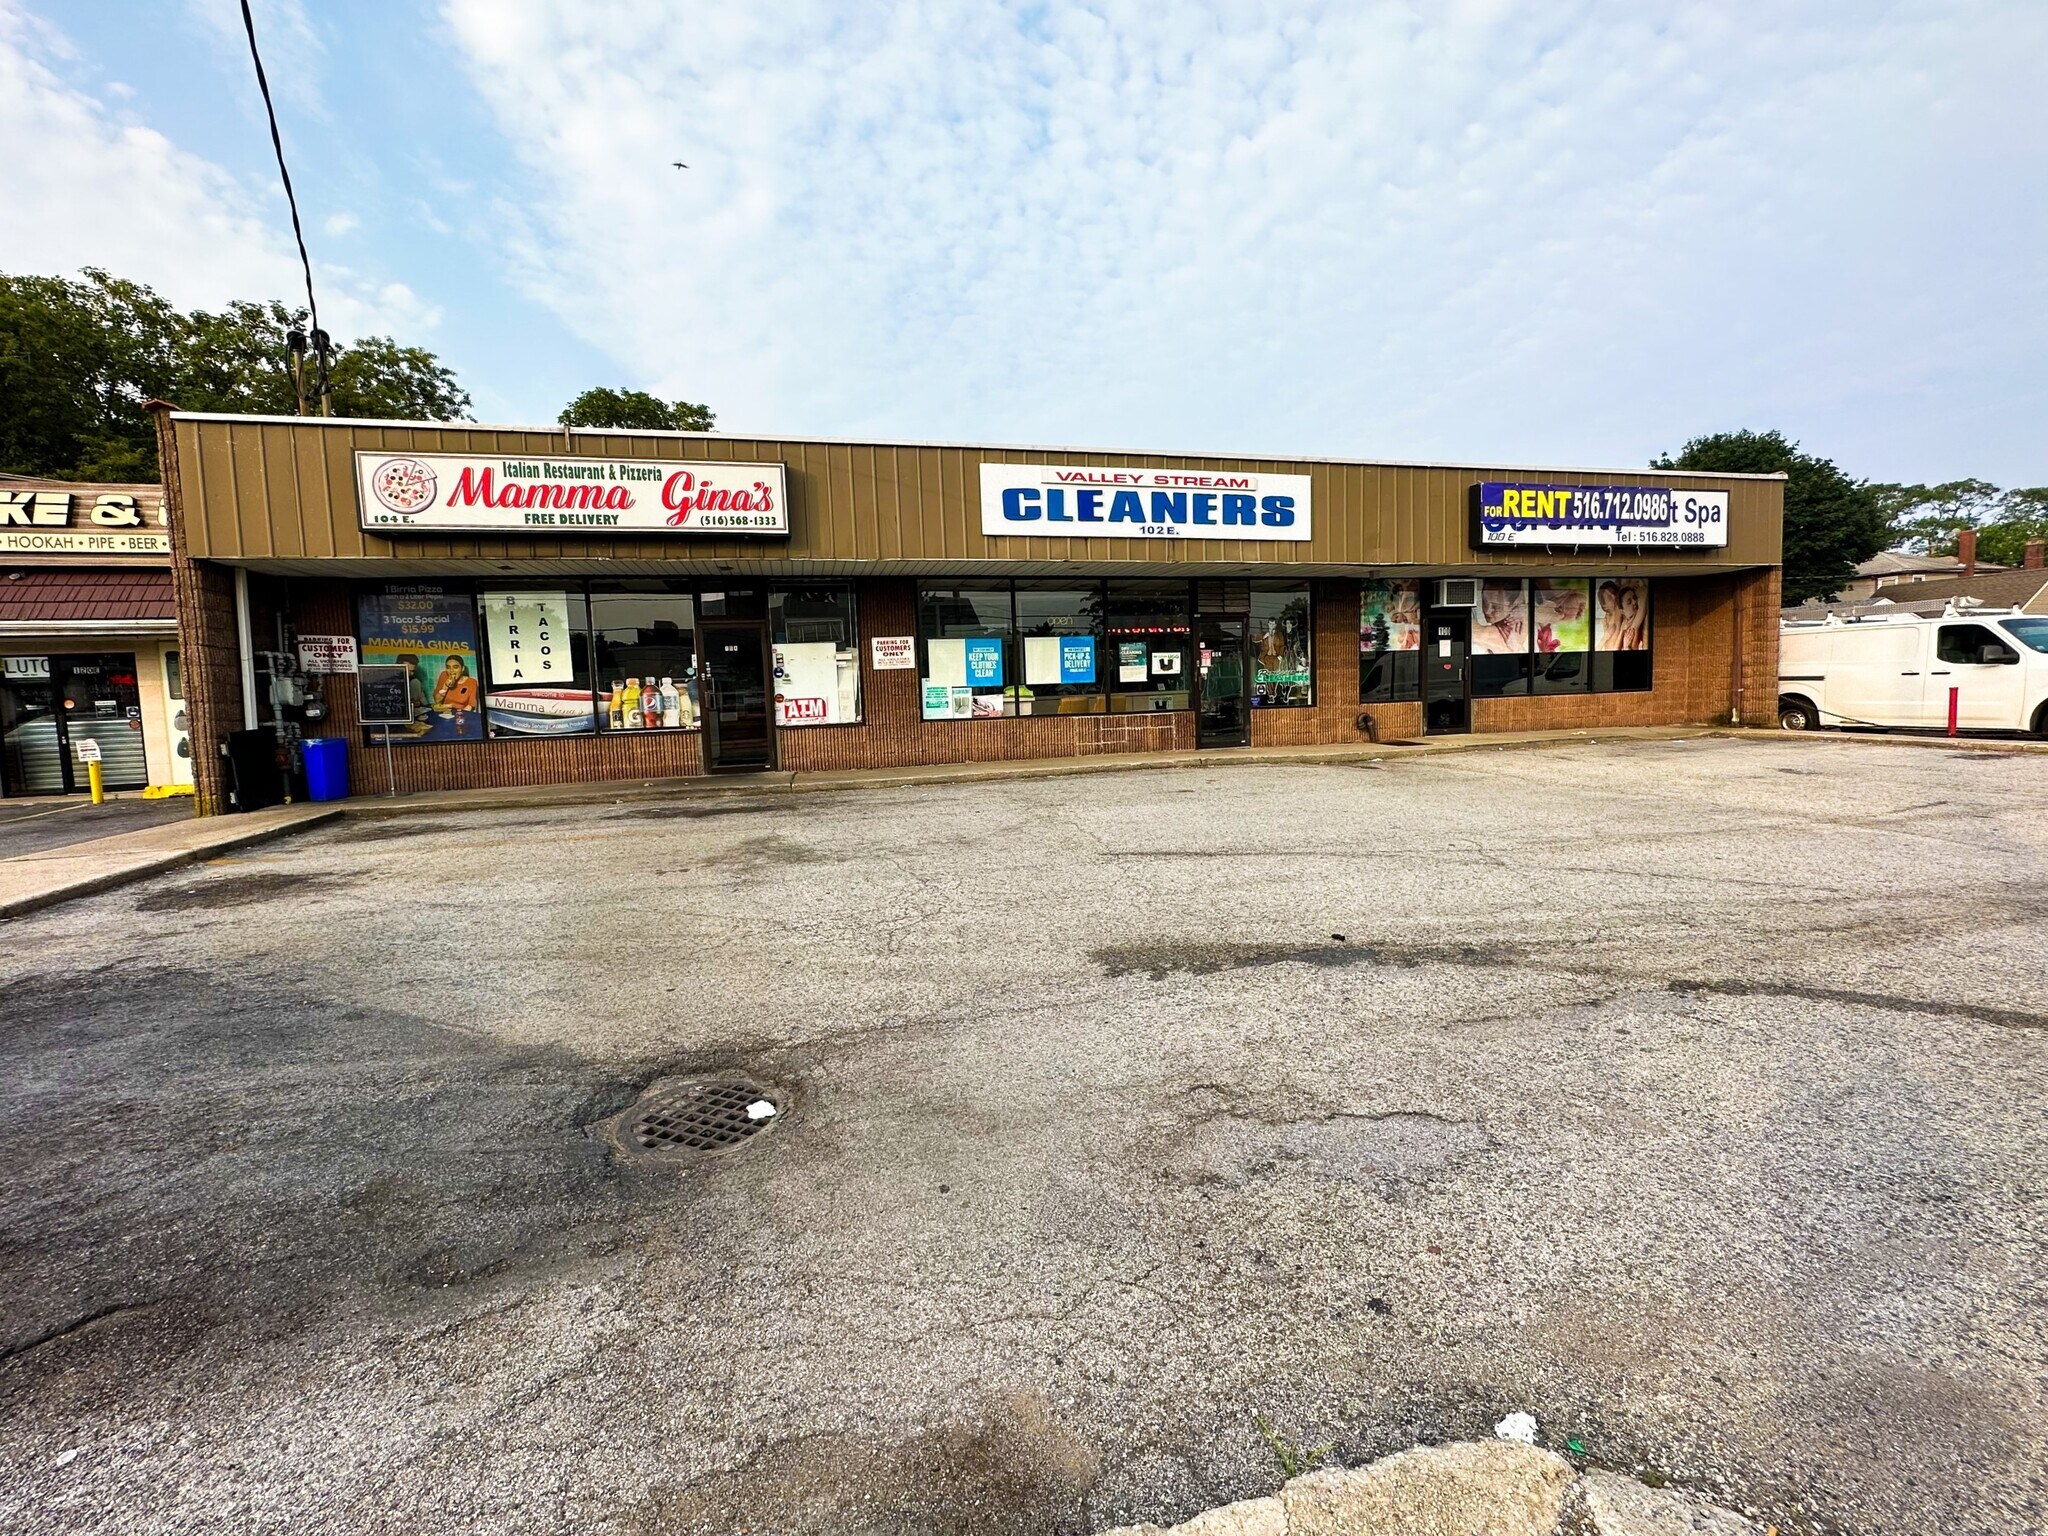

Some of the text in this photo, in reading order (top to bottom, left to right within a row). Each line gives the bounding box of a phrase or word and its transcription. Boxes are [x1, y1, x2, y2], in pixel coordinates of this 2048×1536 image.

[502, 462, 662, 482] Italian Restaurant & Pizzeria
[1056, 472, 1249, 488] VALLEY STREAM
[446, 467, 774, 526] Mamma Gina's
[90, 494, 140, 526] &
[1002, 488, 1295, 526] CLEANERS
[1484, 490, 1668, 521] FOR RENT 516.712.0986
[374, 514, 399, 523] 104
[1684, 498, 1721, 528] Spa
[524, 514, 620, 526] FREE DELIVERY
[700, 515, 776, 527] (516)568-1333
[8, 536, 158, 549] HOOKAH PIPE BEER
[1488, 533, 1516, 541] 100 E
[1639, 532, 1704, 543] 516.828.0888
[398, 601, 434, 610] $32.00
[384, 615, 450, 625] 3 Taco Special
[402, 625, 435, 634] $15.99
[537, 602, 551, 669] TACOS
[506, 596, 523, 678] BIRRIA
[368, 638, 470, 650] MAMMA GINAS
[969, 652, 999, 661] KEEP YOUR
[971, 661, 997, 669] CLOTHES
[1064, 660, 1091, 668] DELIVERY
[975, 669, 994, 677] CLEAN
[495, 698, 545, 713] Mamma
[787, 699, 824, 718] ATM
